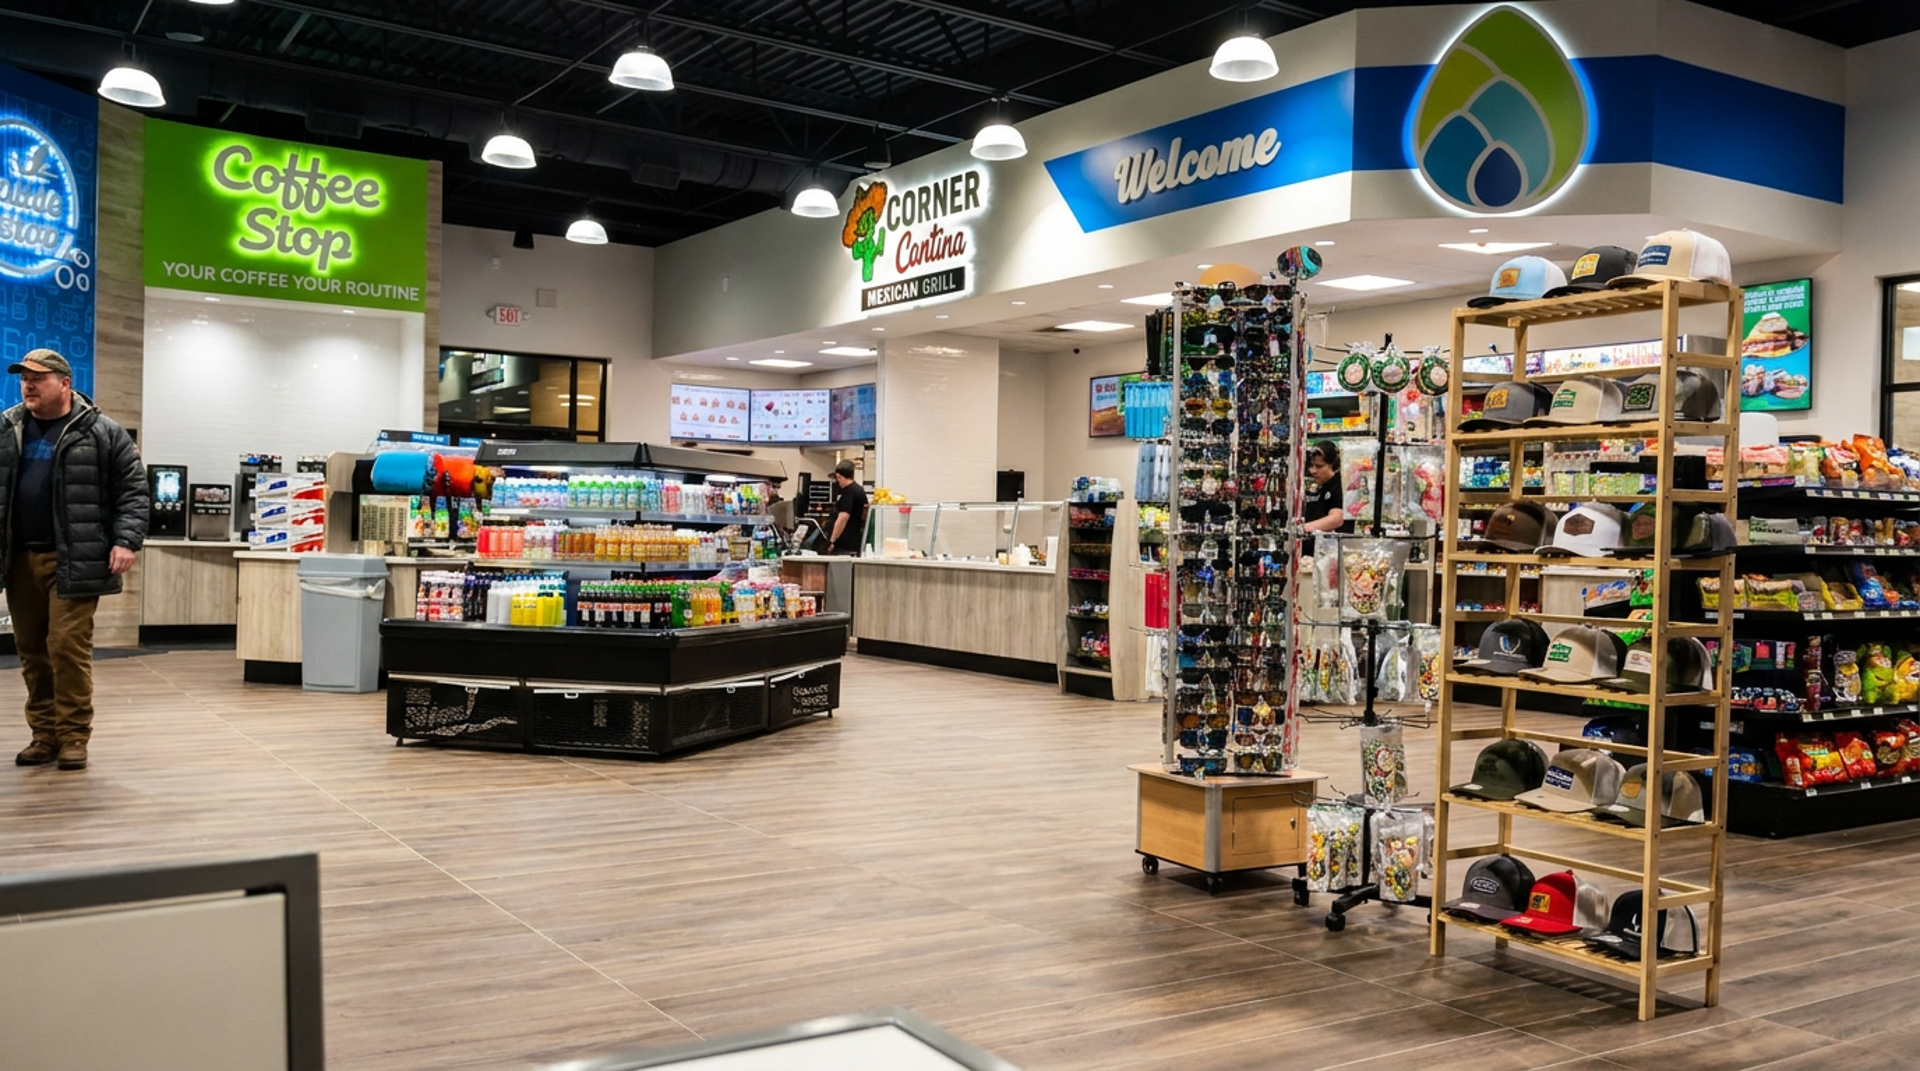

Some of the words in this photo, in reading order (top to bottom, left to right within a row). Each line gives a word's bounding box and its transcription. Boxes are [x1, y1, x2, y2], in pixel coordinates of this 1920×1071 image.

[213, 144, 380, 214] Coffee
[1114, 127, 1282, 205] Welcome
[886, 170, 980, 232] CORNER
[238, 207, 352, 271] Stop
[895, 223, 967, 274] Cantina
[162, 260, 216, 281] YOUR
[219, 267, 289, 289] COFFEE
[291, 274, 342, 295] YOUR
[345, 280, 420, 302] ROUTINE
[867, 280, 919, 308] MEXICAN
[921, 272, 957, 295] GRILL
